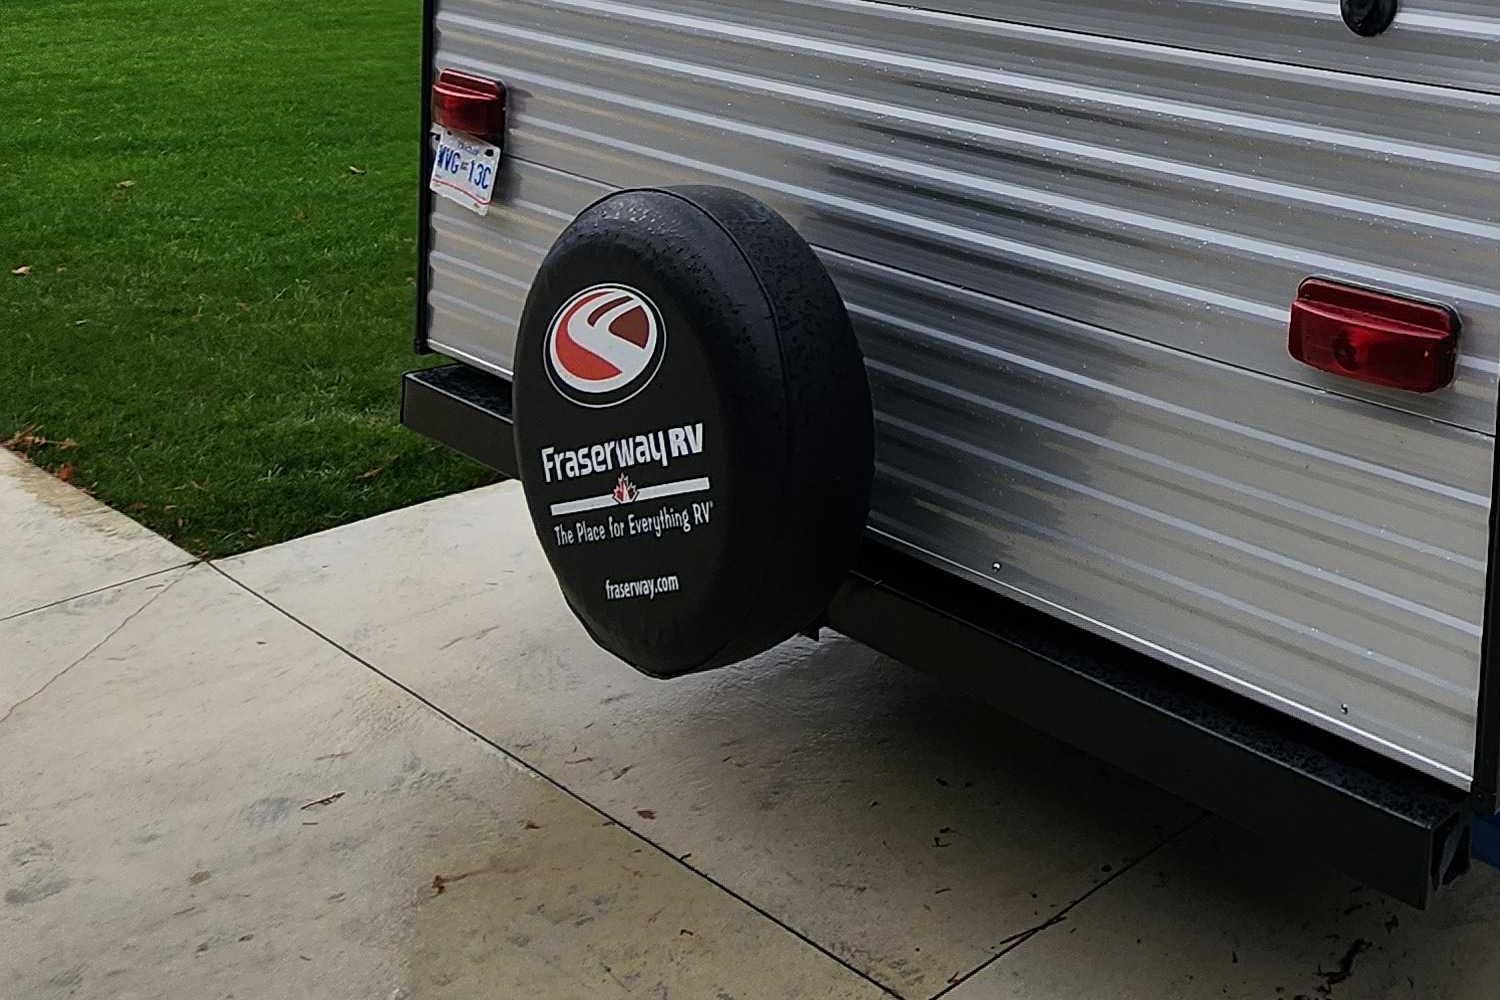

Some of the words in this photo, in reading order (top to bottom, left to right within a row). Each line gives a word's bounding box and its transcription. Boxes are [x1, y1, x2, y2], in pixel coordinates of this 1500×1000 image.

[554, 523, 575, 546] The
[576, 520, 606, 543] Place
[609, 515, 625, 538] for
[628, 506, 692, 537] Everything
[605, 575, 679, 600] fraserway.com
